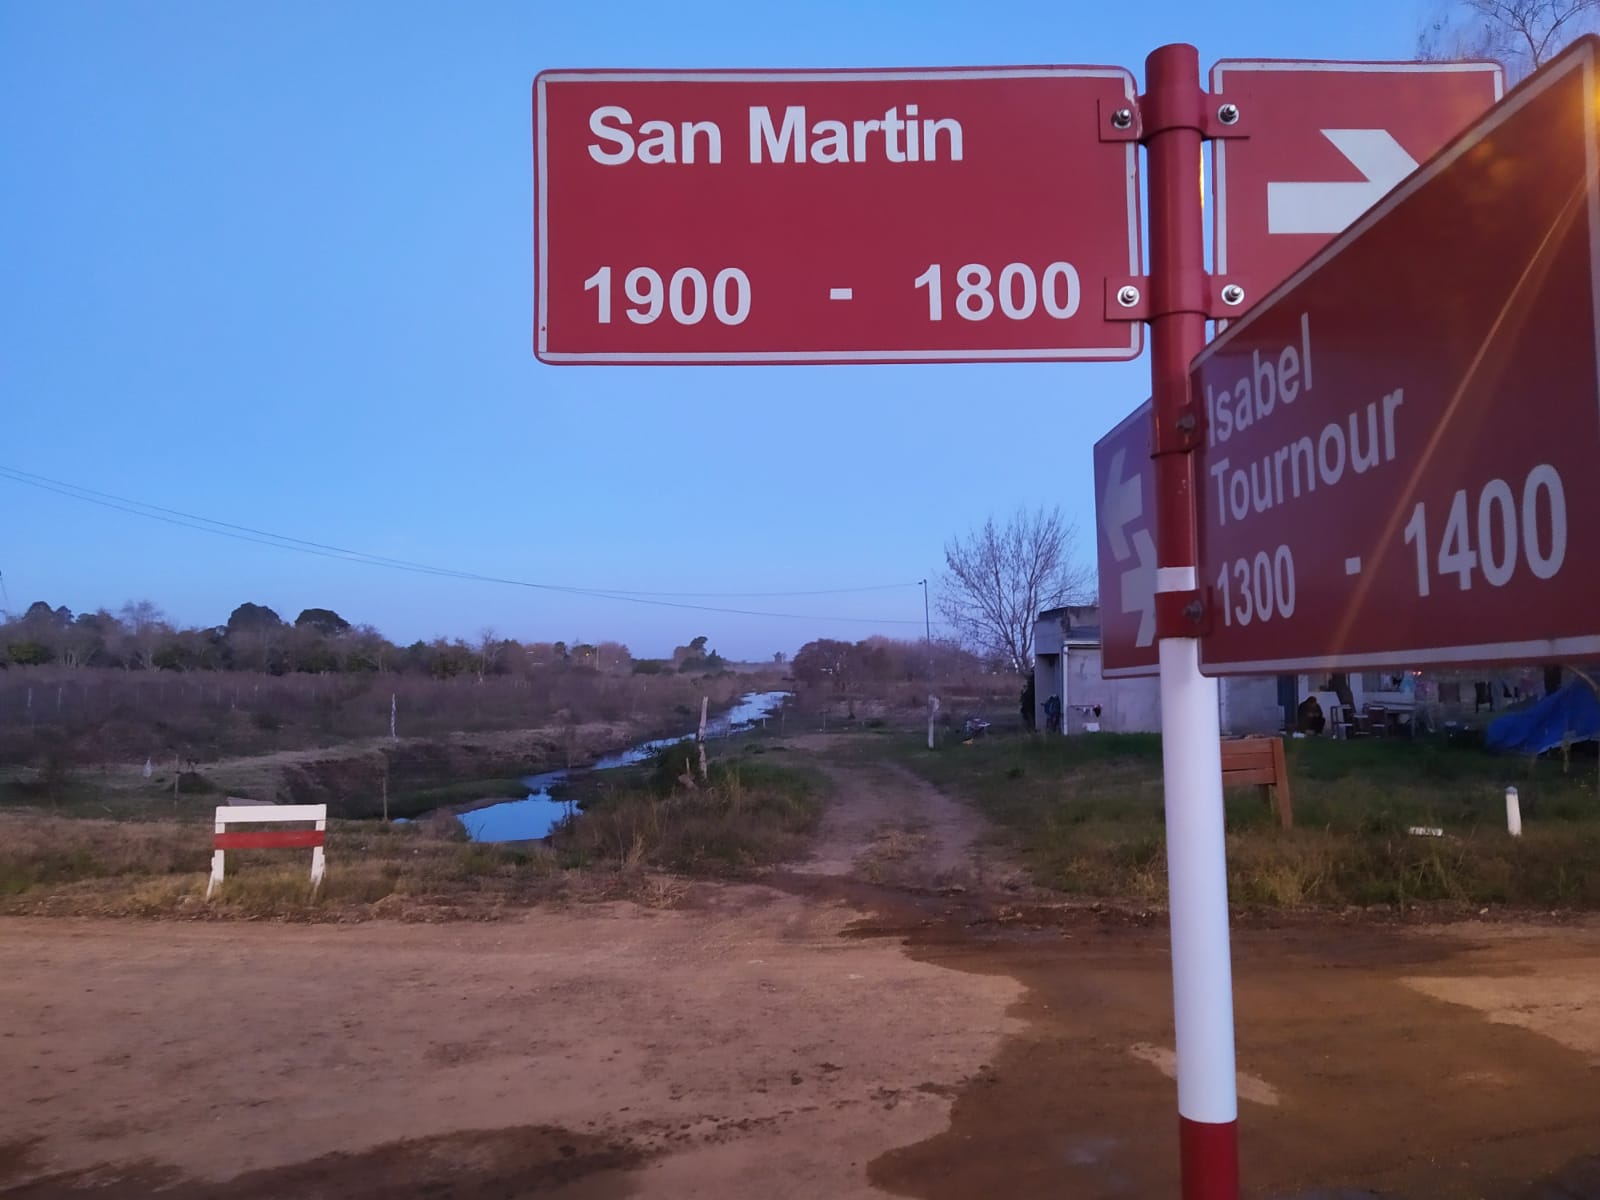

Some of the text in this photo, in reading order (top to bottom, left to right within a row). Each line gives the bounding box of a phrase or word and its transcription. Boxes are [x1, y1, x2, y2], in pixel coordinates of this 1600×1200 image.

[587, 104, 963, 167] San Martin
[584, 262, 1081, 326] 1900 - 1800
[1207, 312, 1313, 447] Isabel
[1210, 388, 1404, 526] Tournour
[1217, 464, 1567, 627] 1300 - 1400
